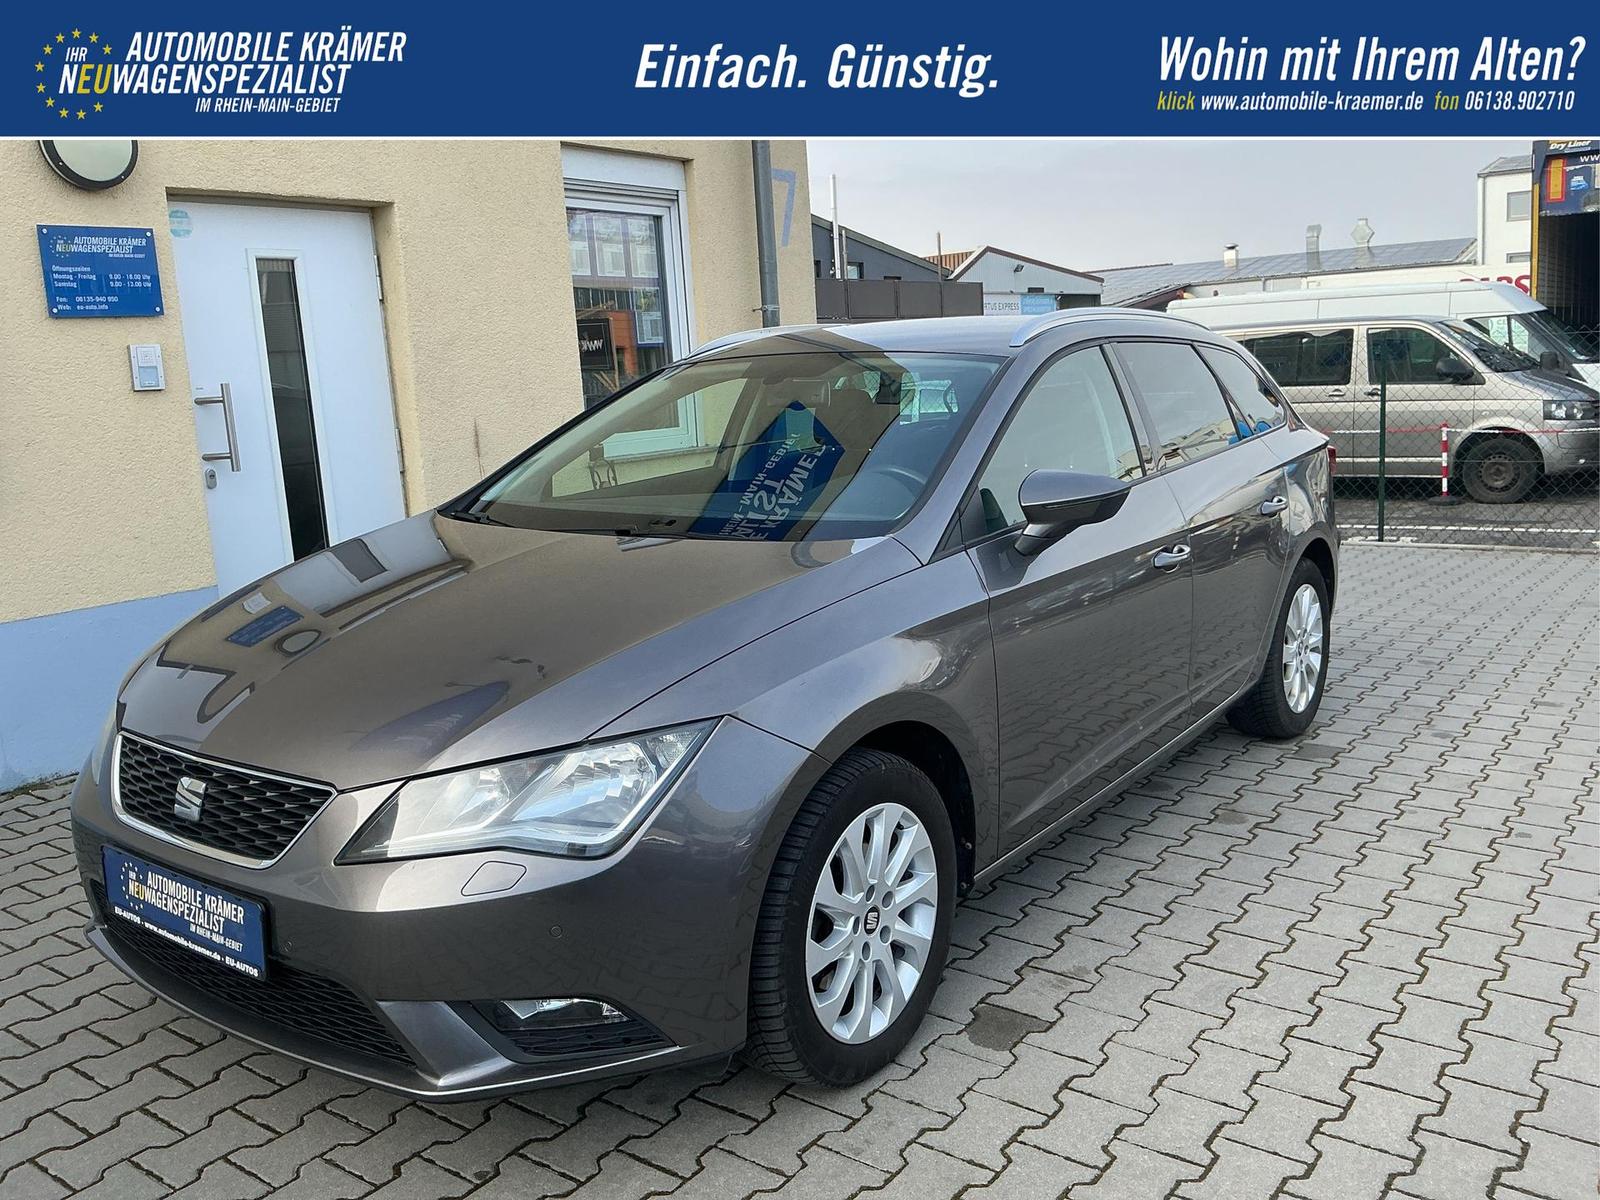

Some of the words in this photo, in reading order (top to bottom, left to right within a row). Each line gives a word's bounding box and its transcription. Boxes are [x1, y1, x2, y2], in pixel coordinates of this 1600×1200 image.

[56, 243, 133, 253] NEUWAGENSPEZIALIST
[74, 236, 117, 246] AUTOMOBILE
[118, 236, 147, 246] KRÄMER
[129, 879, 225, 934] NEUWAGENSPEZIALIST
[147, 871, 202, 908] AUTOMOBILE
[204, 894, 245, 925] KRÄMER
[115, 906, 141, 924] EU-AUTOS
[225, 956, 259, 977] EU-AUTOS
